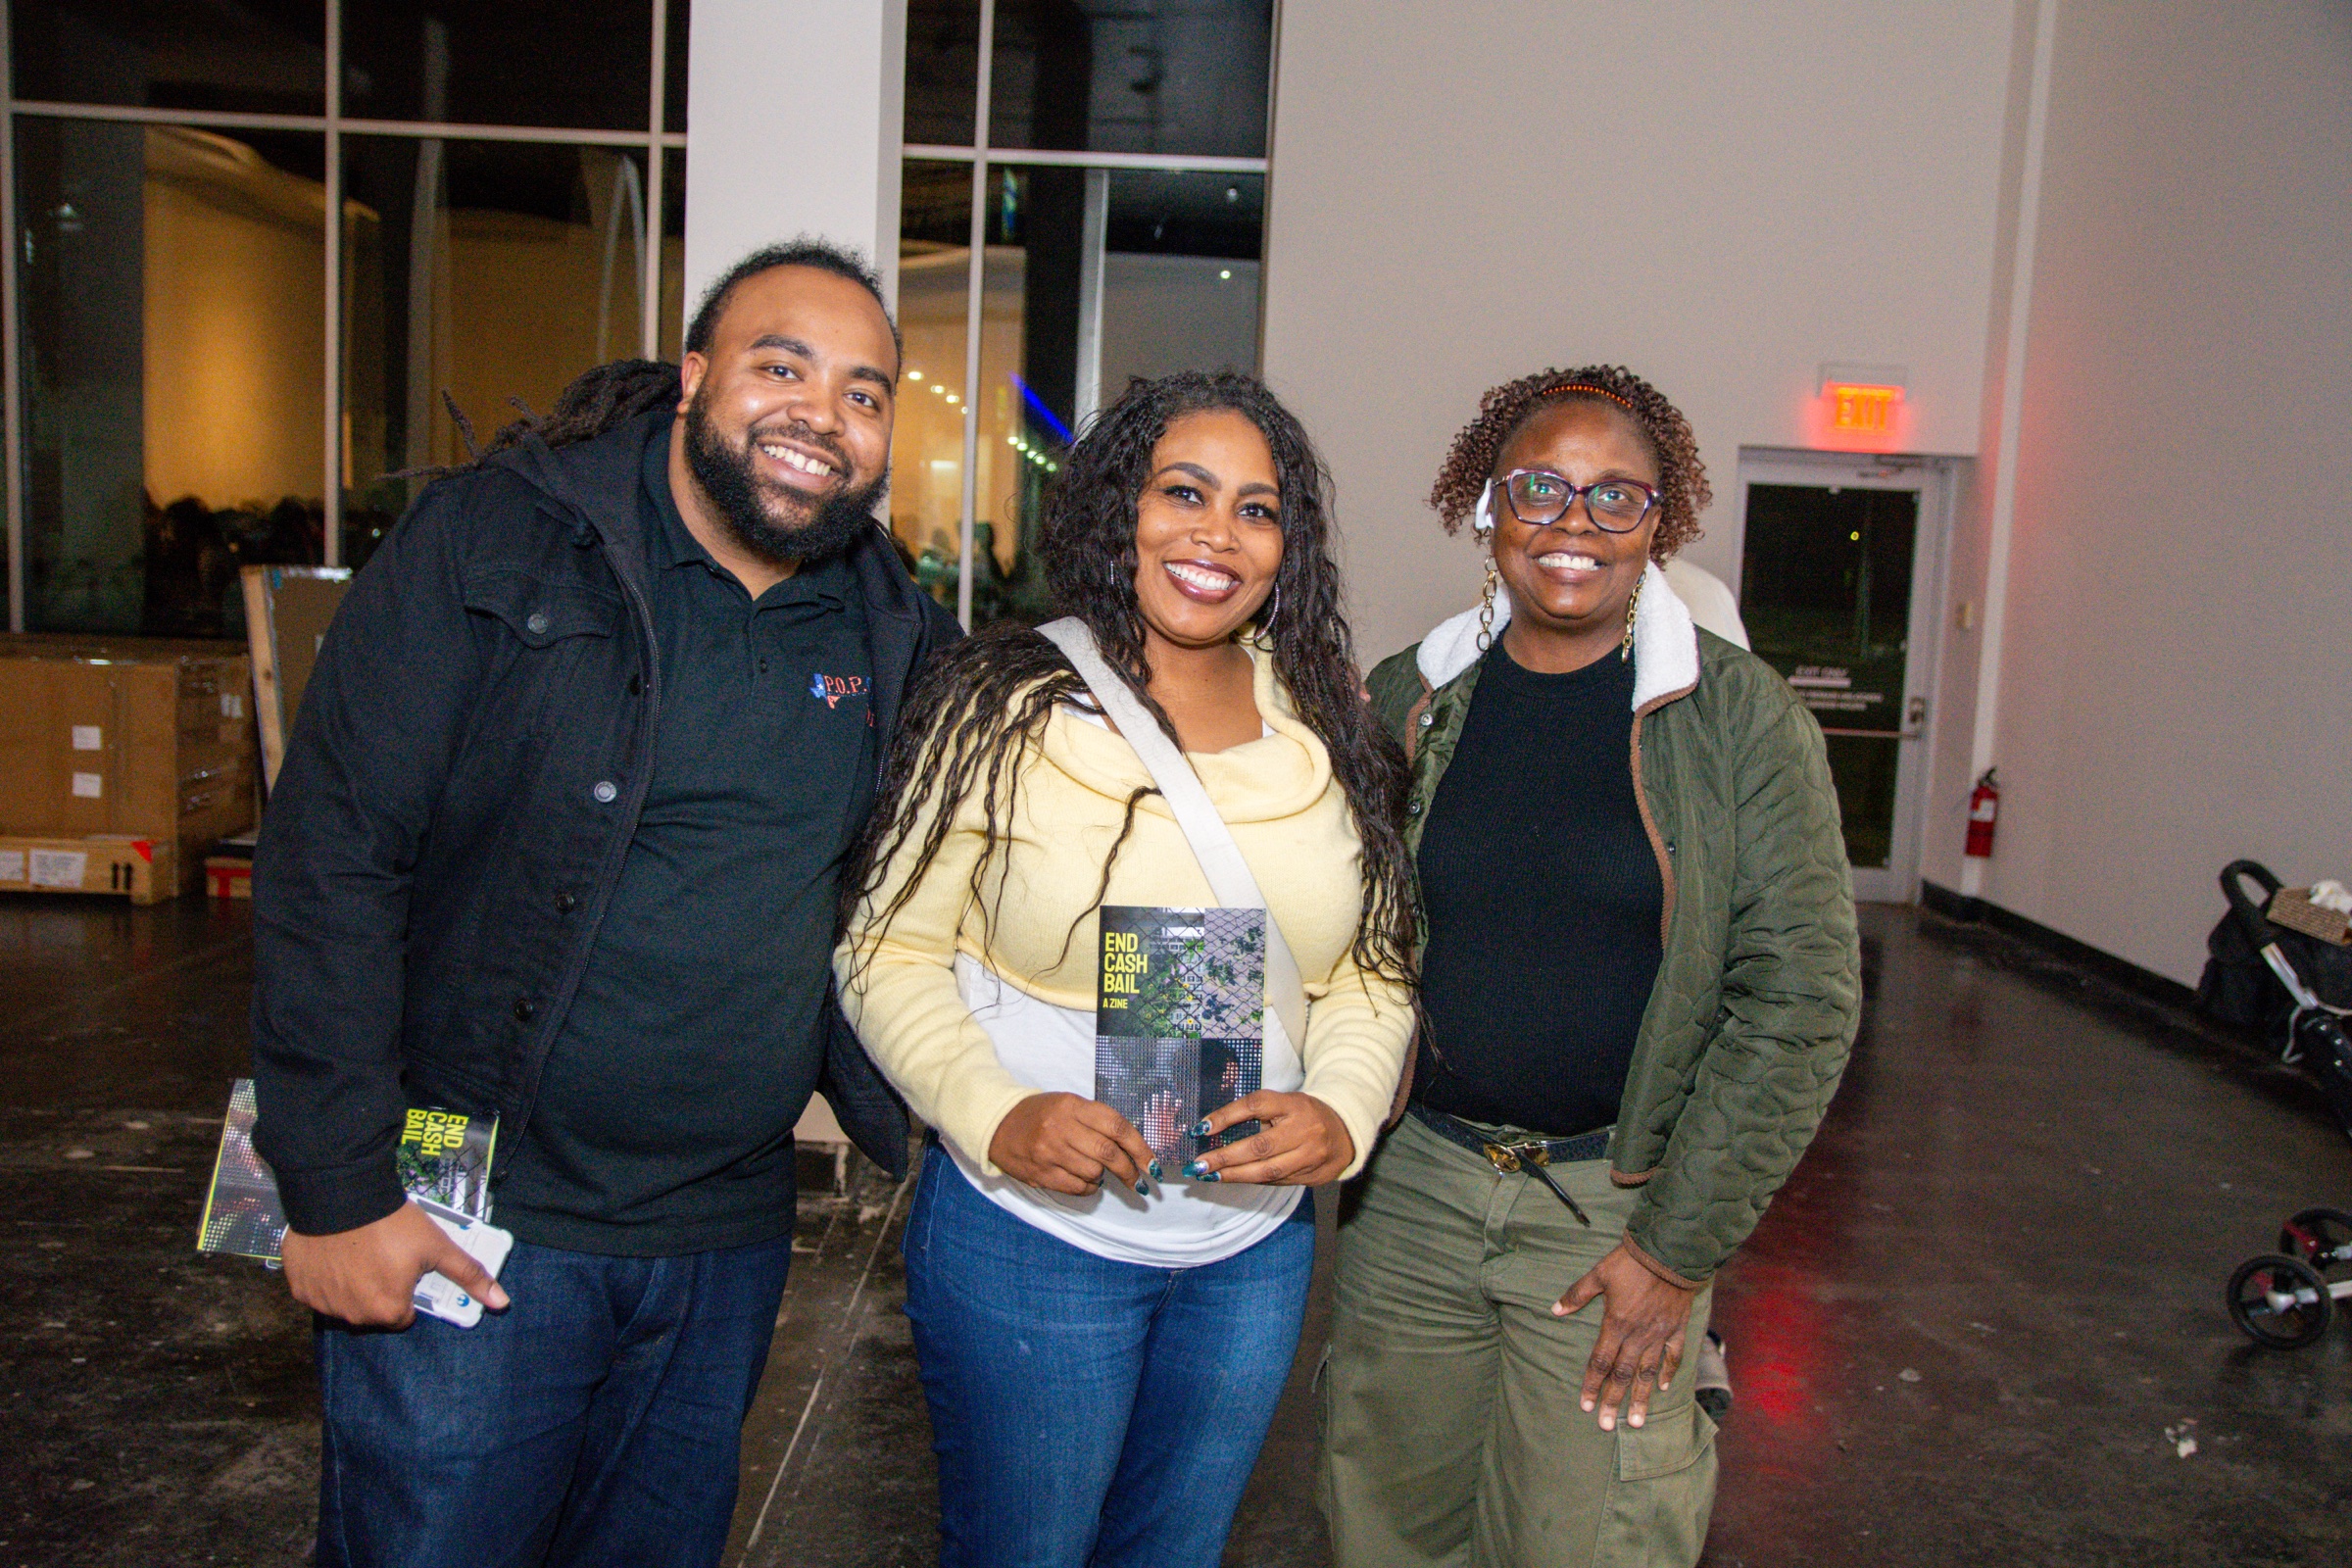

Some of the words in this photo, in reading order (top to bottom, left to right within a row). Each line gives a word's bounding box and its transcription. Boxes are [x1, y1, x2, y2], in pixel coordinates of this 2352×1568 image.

[1834, 386, 1895, 430] EXIT
[1104, 932, 1139, 953] END
[1103, 952, 1149, 974] CASH
[1103, 972, 1141, 994] BAIL
[1102, 998, 1108, 1008] A
[1109, 998, 1128, 1009] ZINE
[401, 1108, 428, 1145] BAIL
[420, 1111, 448, 1156] CASH
[443, 1114, 469, 1149] END
